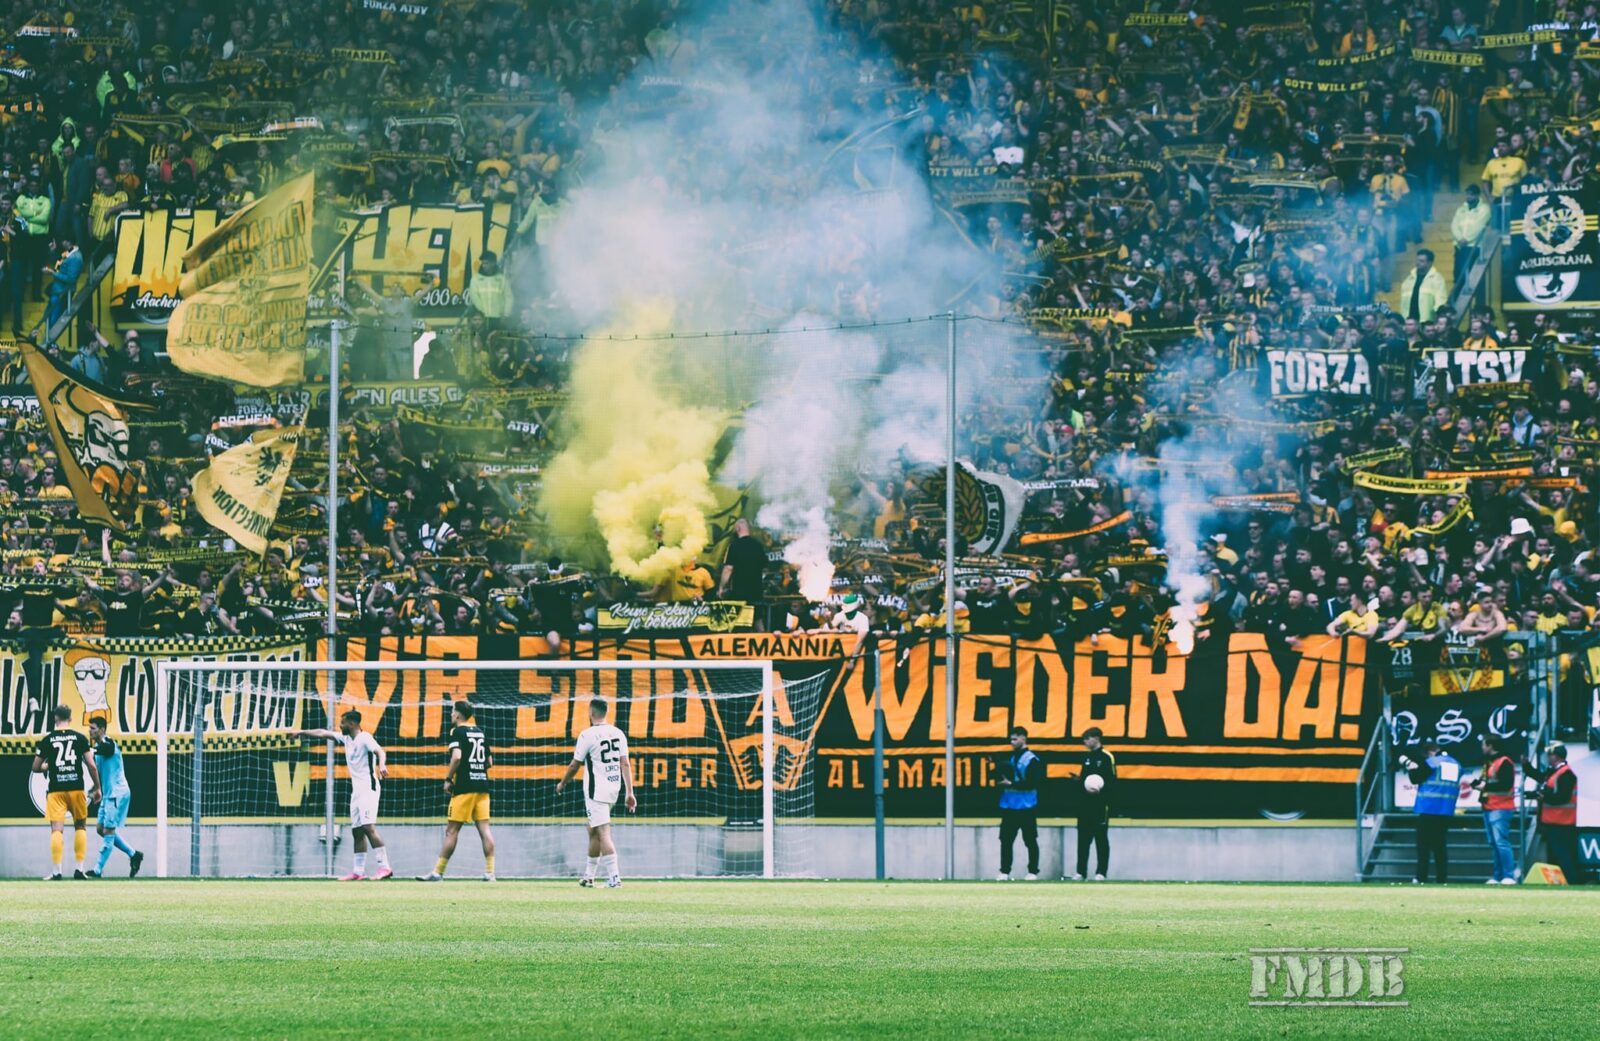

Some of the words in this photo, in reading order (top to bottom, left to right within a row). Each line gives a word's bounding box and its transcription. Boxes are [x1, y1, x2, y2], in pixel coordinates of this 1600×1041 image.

[1350, 51, 1377, 65] WILL
[1284, 77, 1313, 91] GOTT
[1317, 82, 1347, 93] WILL
[1520, 254, 1592, 270] AQUISGRANA
[1267, 351, 1372, 395] FORZA
[391, 387, 441, 405] ALLES
[238, 405, 274, 415] FORZA
[507, 420, 540, 435] ATSV
[205, 435, 236, 450] FORZ
[610, 602, 650, 618] Keine
[654, 600, 712, 618] Sekunde
[628, 615, 652, 634] je
[700, 637, 845, 657] ALEMANNIA
[1223, 632, 1366, 741] DA!
[52, 740, 77, 768] 24
[468, 737, 486, 763] 26
[600, 738, 620, 764] 25
[629, 758, 717, 788] UPER
